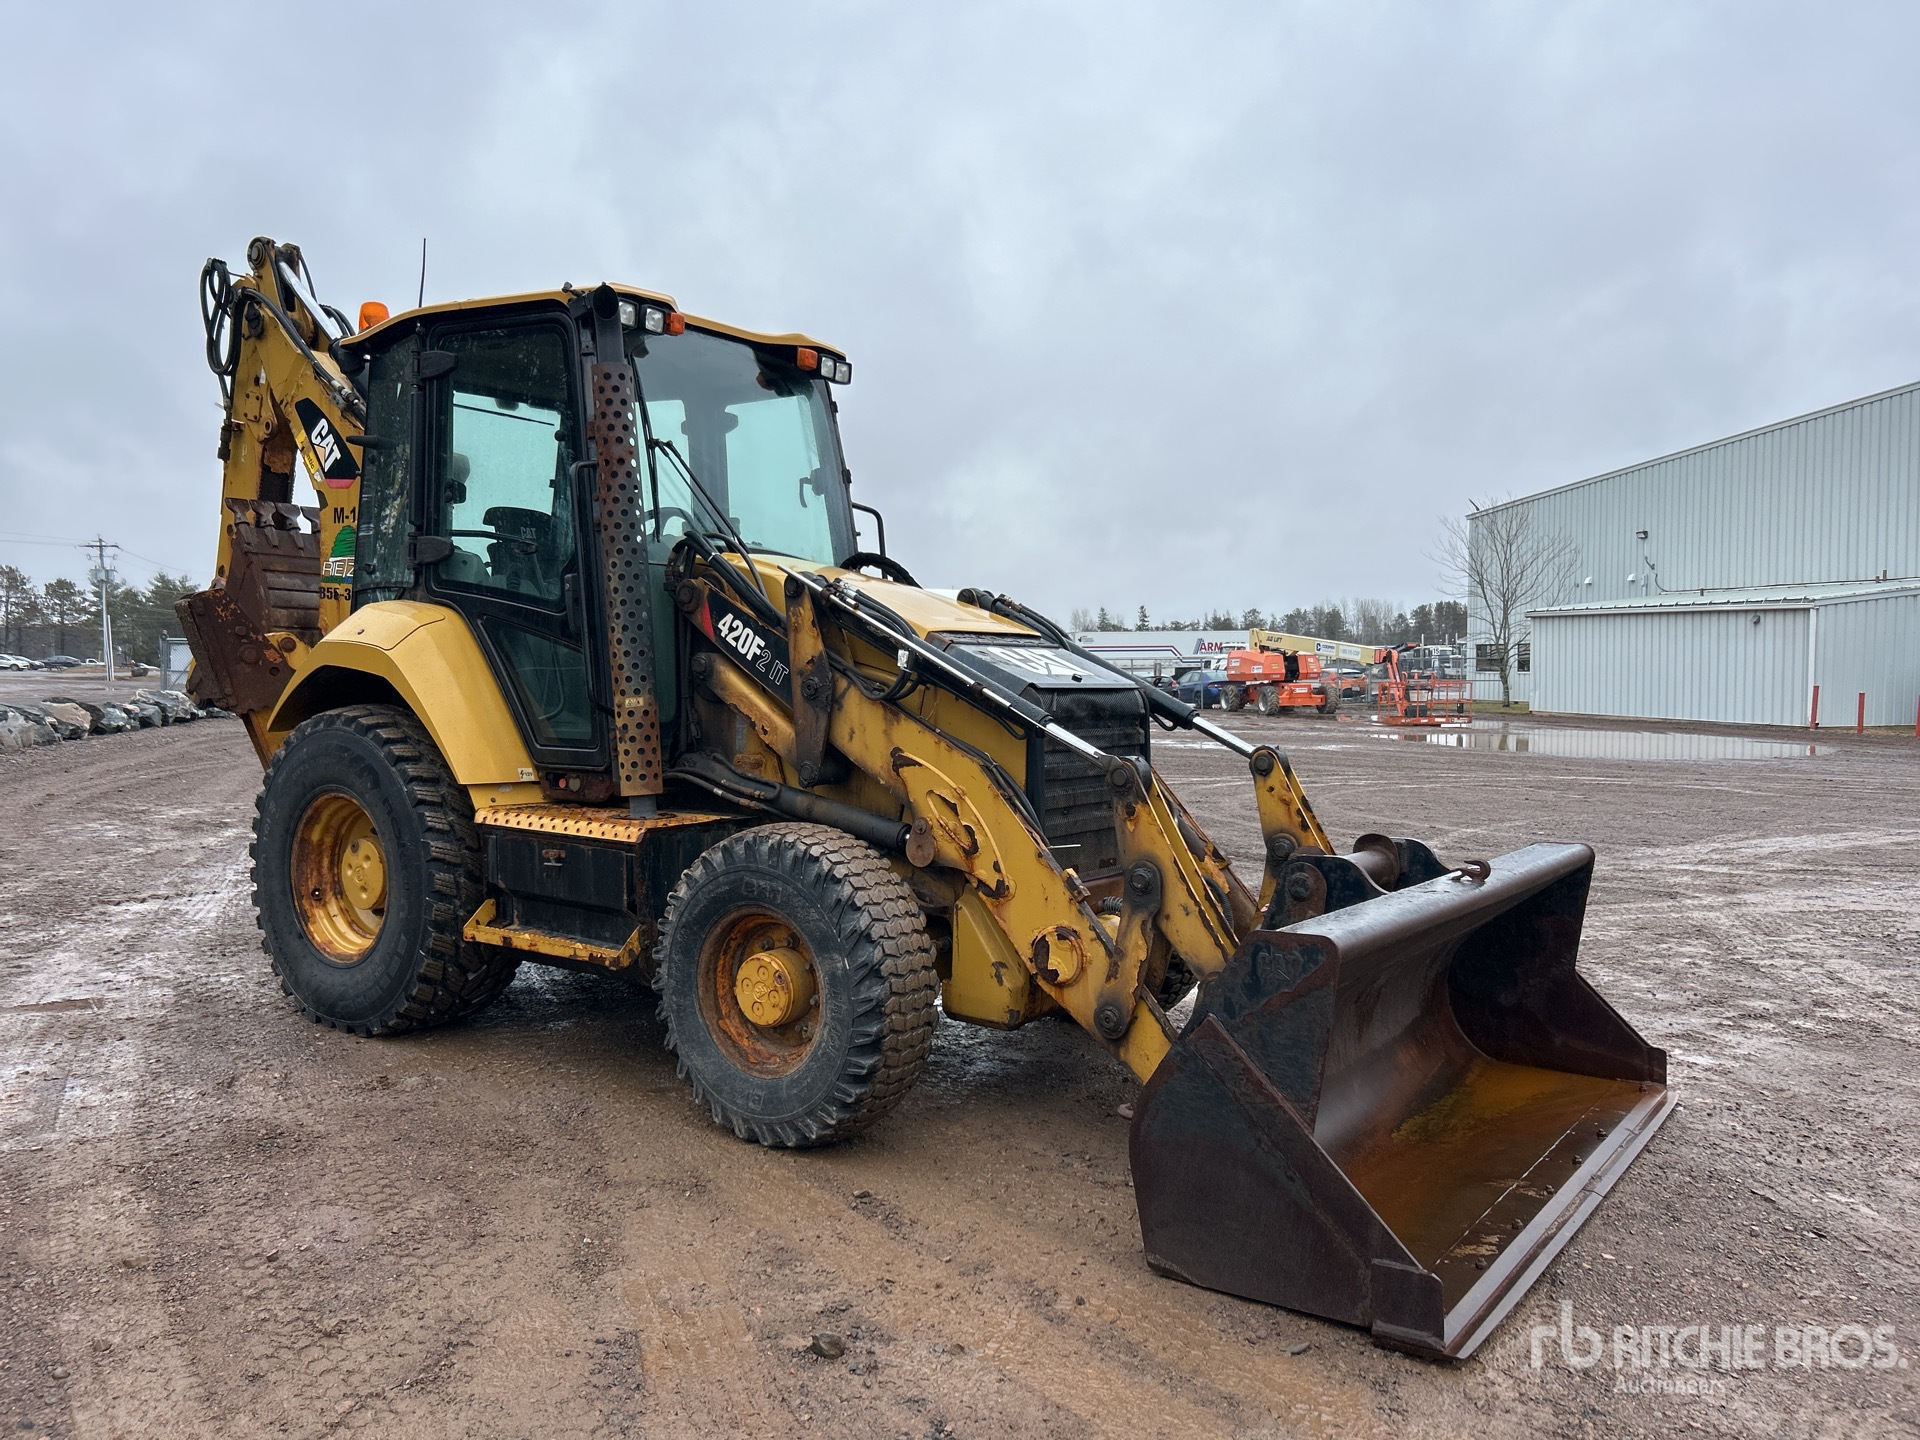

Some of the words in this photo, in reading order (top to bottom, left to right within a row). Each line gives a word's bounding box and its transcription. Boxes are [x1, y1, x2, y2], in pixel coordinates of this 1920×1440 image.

[311, 418, 341, 472] CAT
[520, 526, 536, 539] CAT
[768, 659, 789, 686] IT
[986, 646, 1095, 676] CAT
